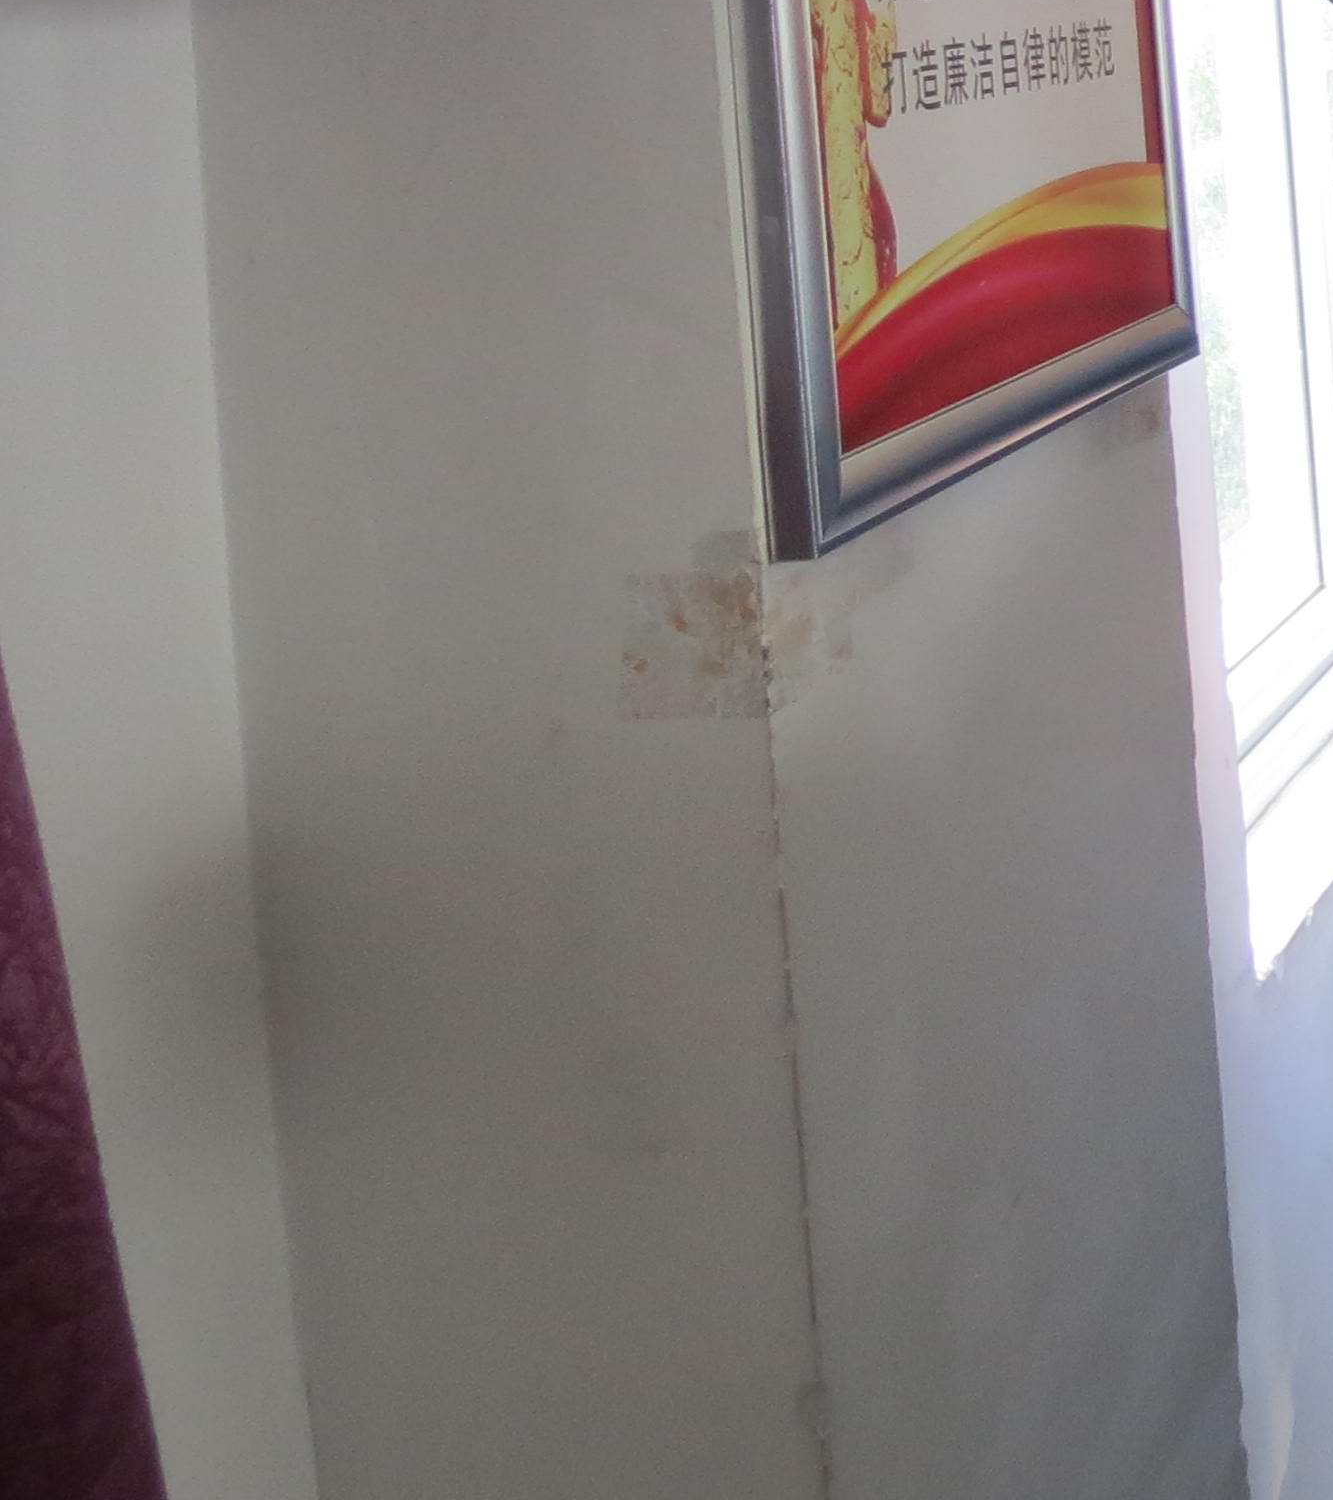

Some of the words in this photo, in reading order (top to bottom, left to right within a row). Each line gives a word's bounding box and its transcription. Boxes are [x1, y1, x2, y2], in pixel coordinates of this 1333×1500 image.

[881, 17, 1116, 119] 打造廉洁自律的模范
